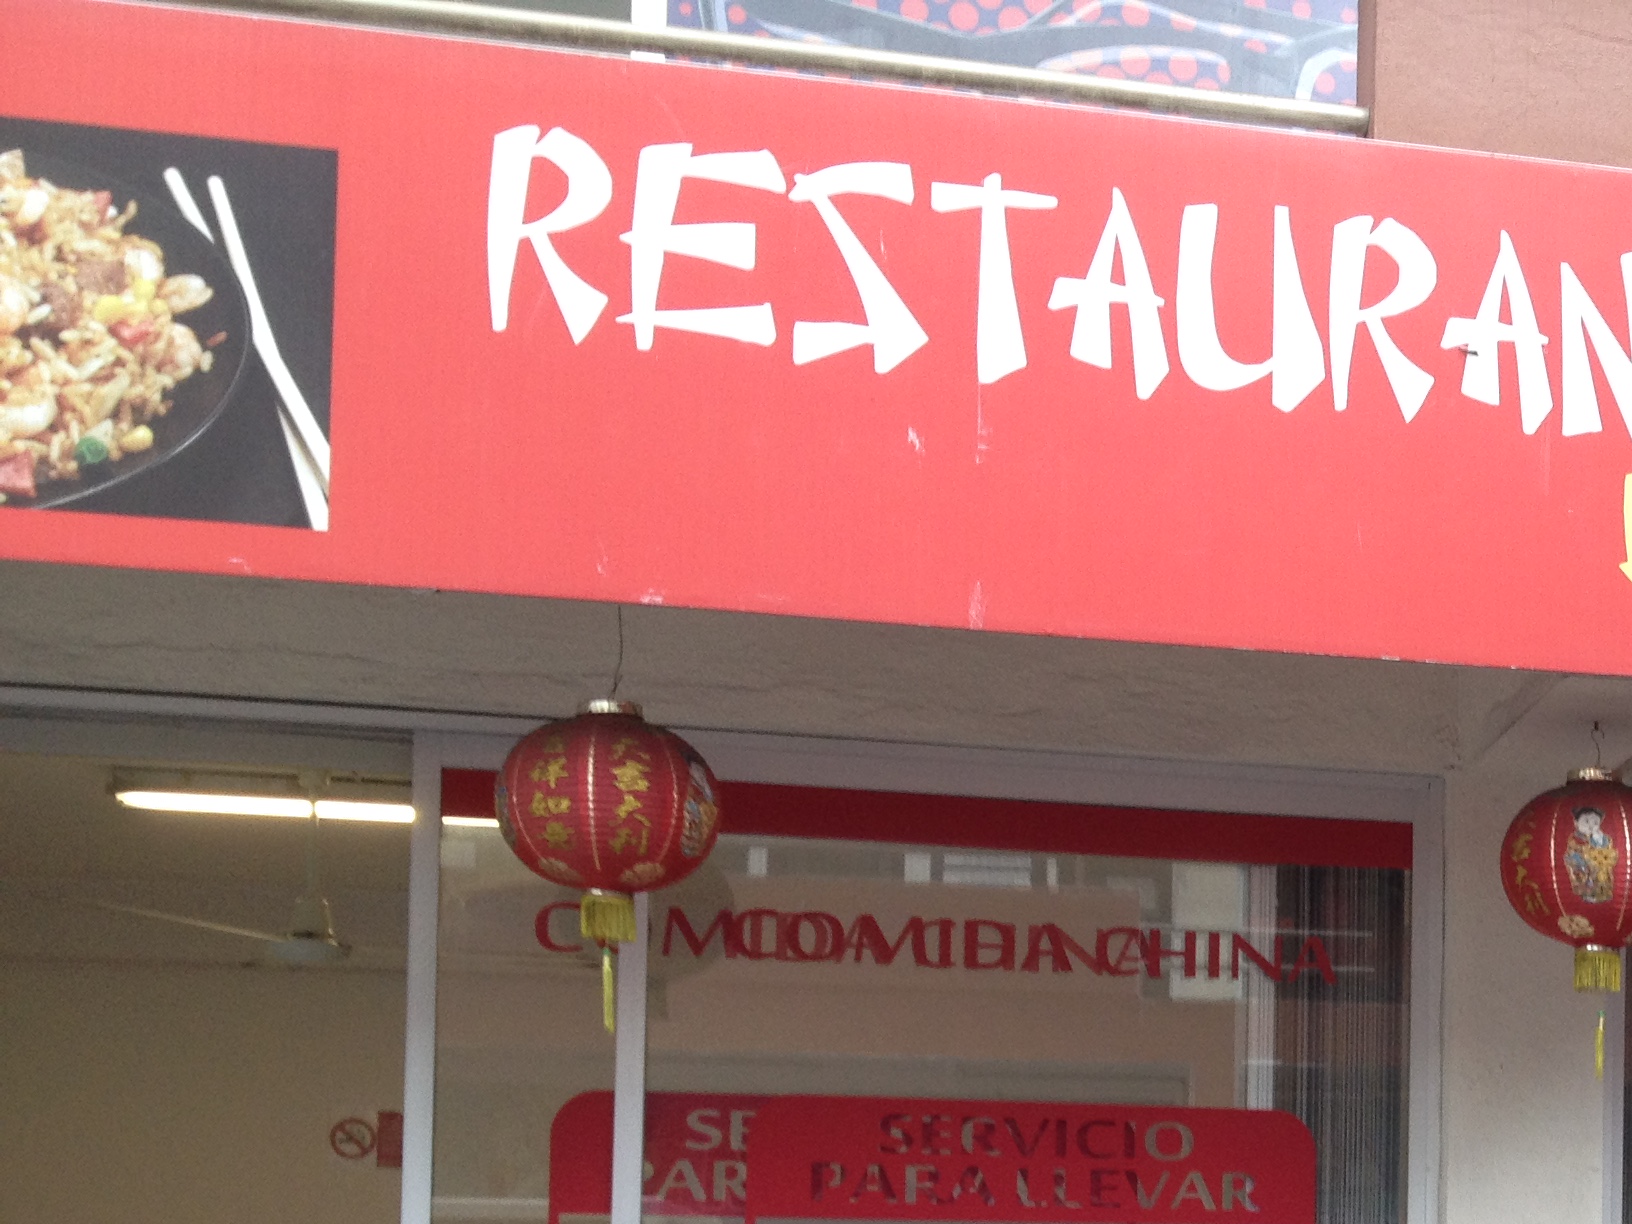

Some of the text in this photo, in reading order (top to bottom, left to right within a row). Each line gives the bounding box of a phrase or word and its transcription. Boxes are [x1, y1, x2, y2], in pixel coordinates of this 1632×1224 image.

[878, 1112, 1194, 1163] SERVICIO
[811, 1161, 1260, 1213] PARA LLEVAR
